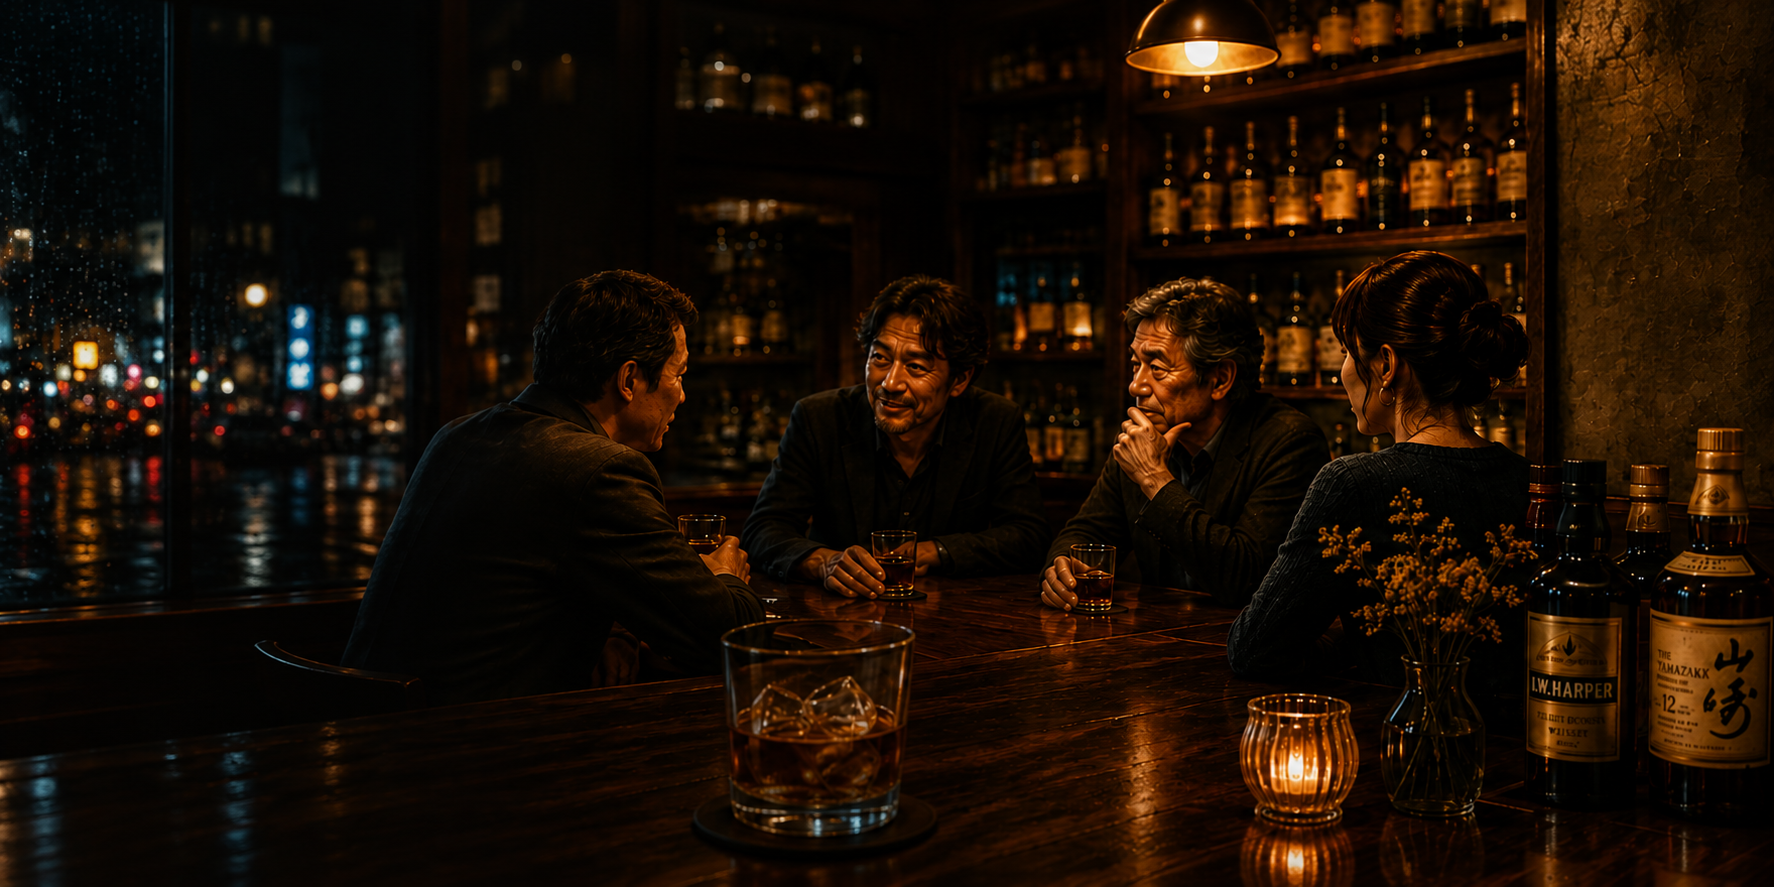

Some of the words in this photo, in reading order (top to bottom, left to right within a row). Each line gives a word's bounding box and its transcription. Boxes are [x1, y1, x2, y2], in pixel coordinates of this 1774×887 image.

[1657, 649, 1672, 661] THE
[1531, 676, 1613, 699] I.W.HARPER
[1662, 693, 1676, 714] 12
